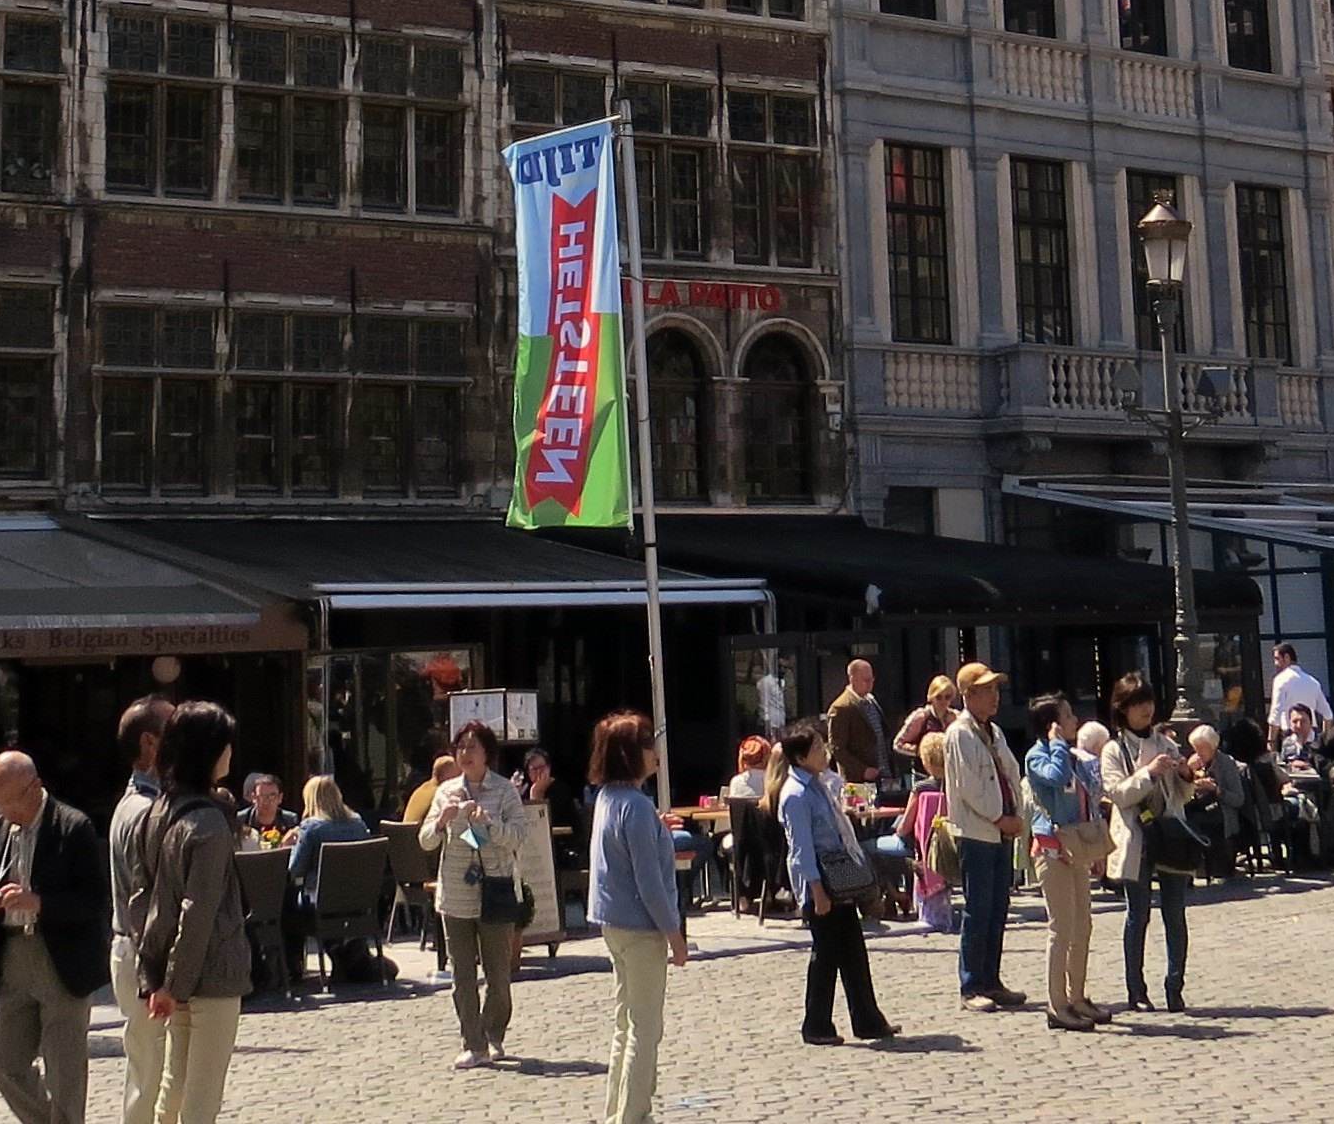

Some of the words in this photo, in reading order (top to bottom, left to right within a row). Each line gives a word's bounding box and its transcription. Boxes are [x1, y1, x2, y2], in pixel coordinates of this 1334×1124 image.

[688, 280, 780, 312] PATIO
[49, 629, 129, 653] Belgian
[140, 626, 251, 651] Specialties
